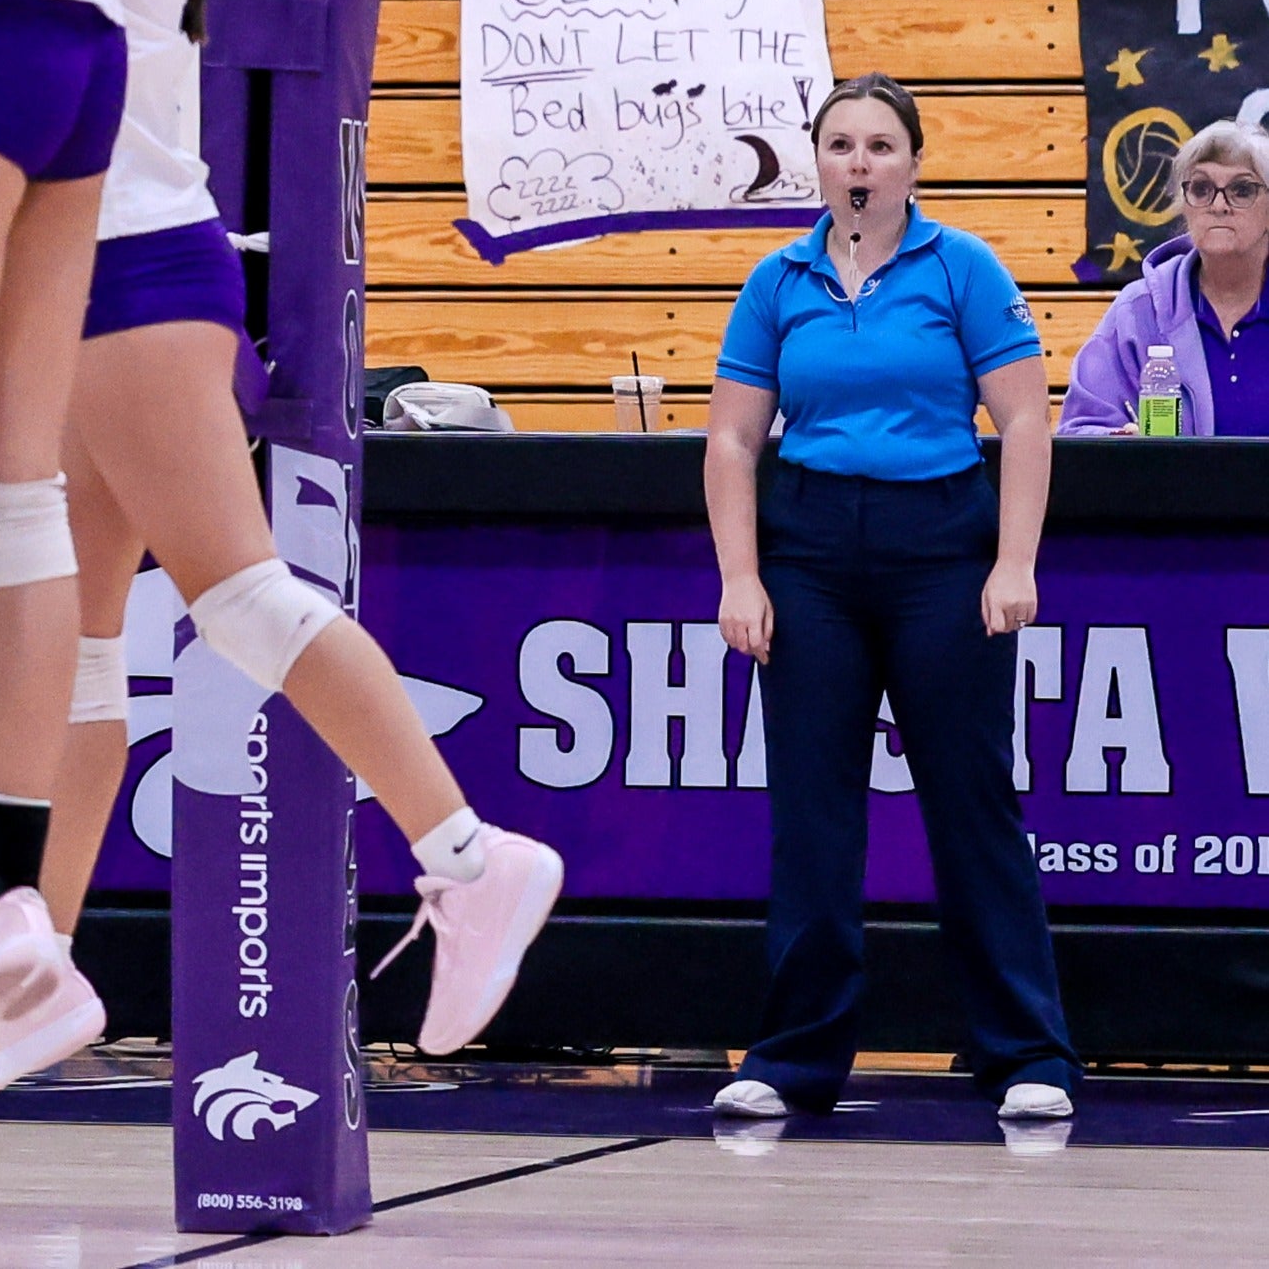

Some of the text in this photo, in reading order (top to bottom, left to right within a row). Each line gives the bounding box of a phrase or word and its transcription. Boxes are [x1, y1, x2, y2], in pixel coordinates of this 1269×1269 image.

[481, 23, 808, 77] DON'T LET THE
[511, 83, 587, 137] Bed
[614, 86, 702, 150] bugs
[518, 619, 1170, 794] SHTA
[1135, 834, 1177, 873] of
[232, 853, 273, 1018] imports
[197, 1193, 303, 1211] (800) 556-3198
